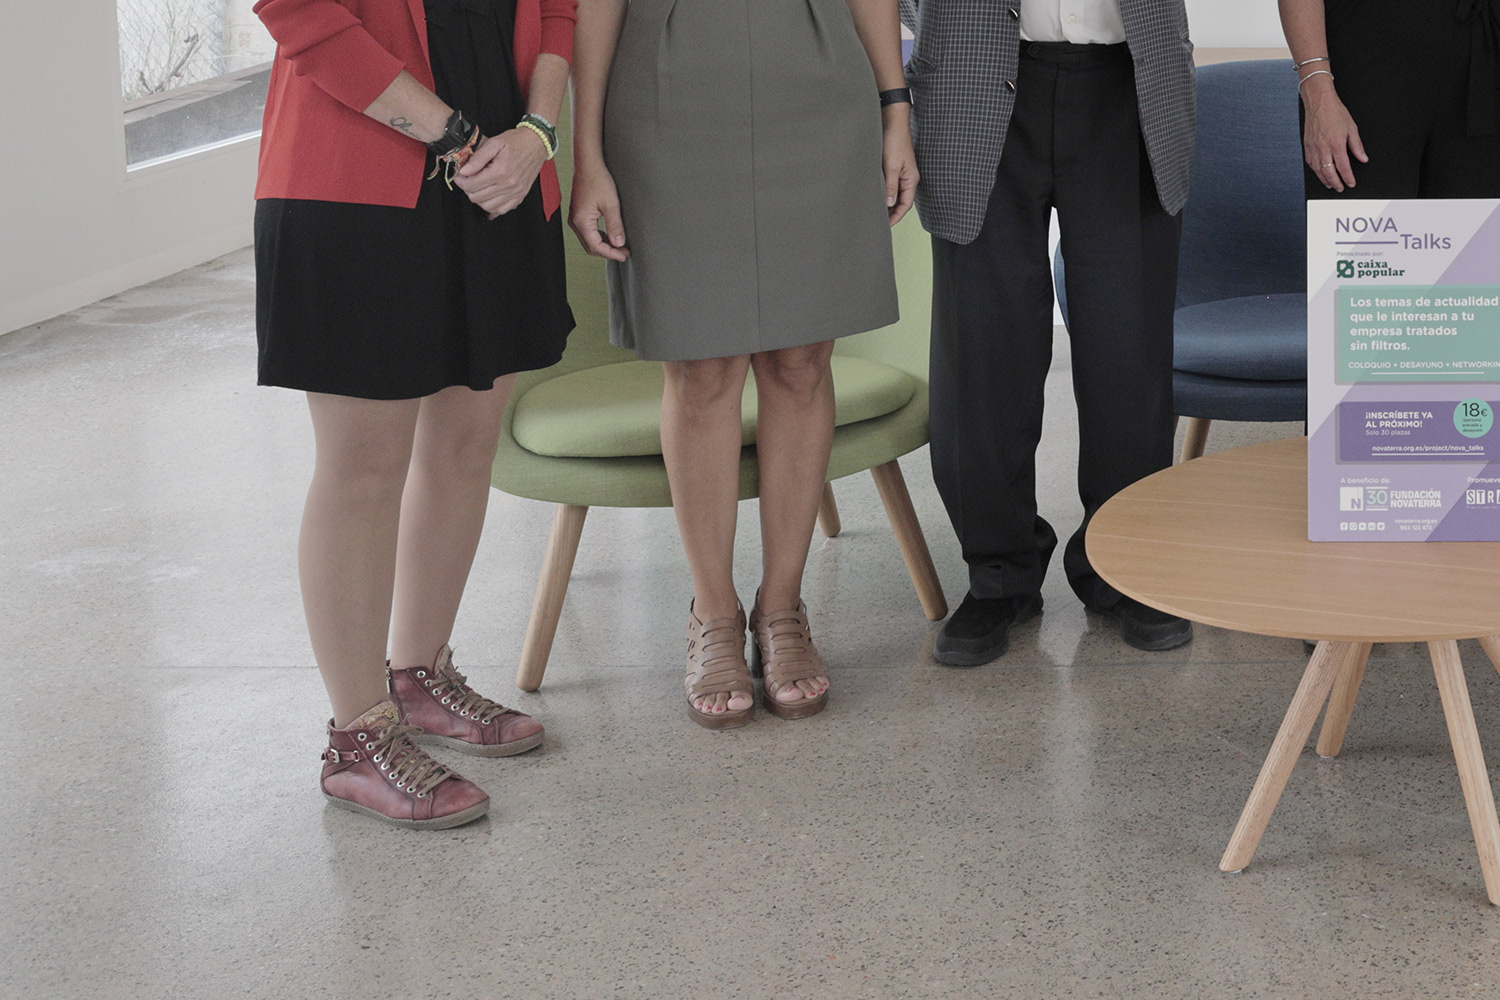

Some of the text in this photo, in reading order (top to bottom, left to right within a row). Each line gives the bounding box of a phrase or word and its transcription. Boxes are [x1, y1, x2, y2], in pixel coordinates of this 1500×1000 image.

[1336, 217, 1398, 233] NOVA
[1400, 233, 1451, 250] Talks
[1357, 260, 1388, 269] caixa
[1357, 268, 1405, 278] popular
[1350, 296, 1499, 307] Los temas de actualidad
[1350, 311, 1474, 323] que le interesan a tu
[1350, 325, 1457, 337] empresa tratados
[1350, 340, 1410, 351] sin filtros.
[1348, 361, 1391, 369] COLOQUIO
[1365, 410, 1420, 419] ¡INSCRÍBETE
[1462, 403, 1487, 417] 18€
[1379, 419, 1423, 428] PRÓXIMO!
[1372, 444, 1484, 452] novaterra.org.es/project/nova_talks
[1366, 490, 1388, 504] 30
[1390, 488, 1441, 499] FUNDACIÓN
[1390, 499, 1442, 508] NOVATERRA
